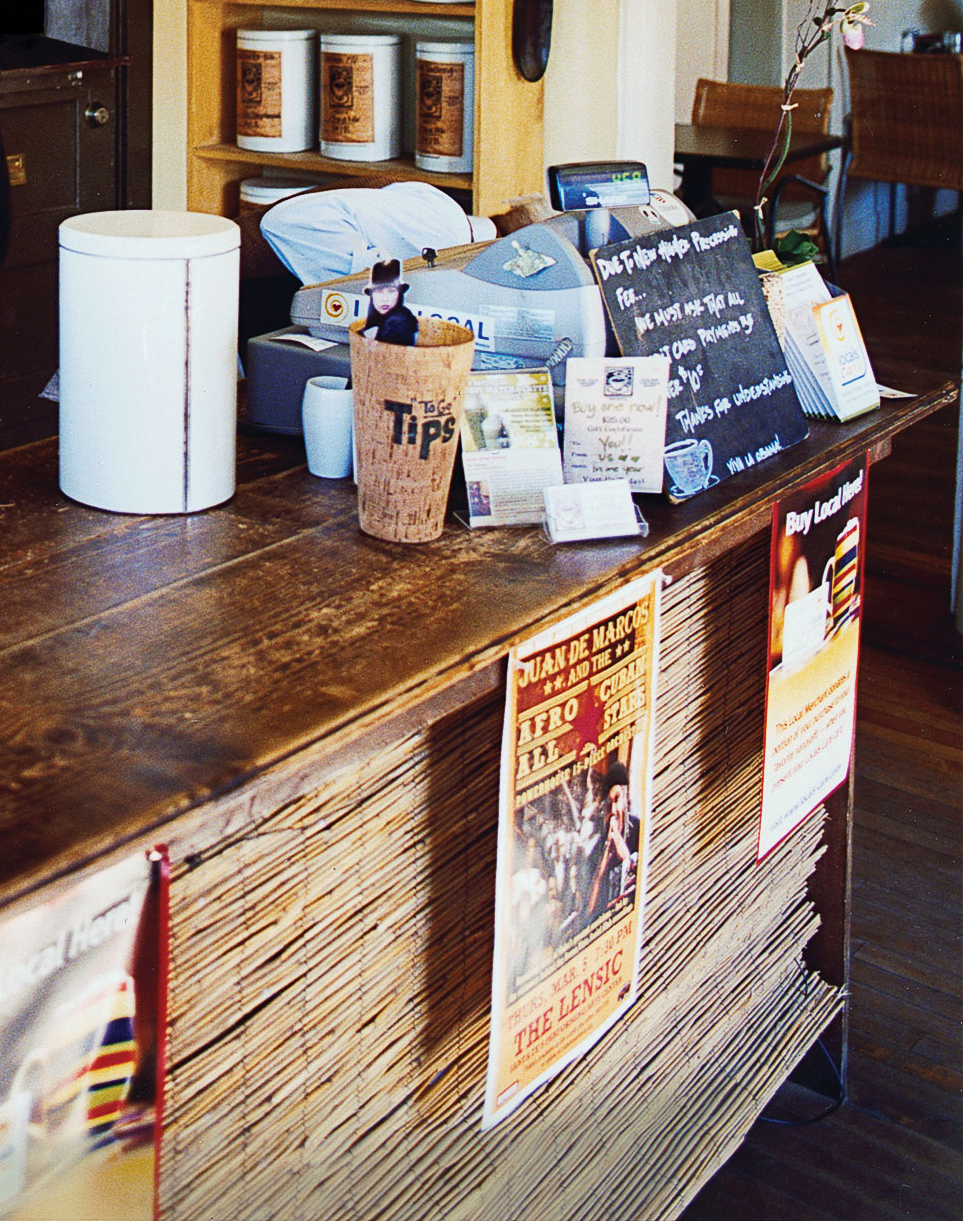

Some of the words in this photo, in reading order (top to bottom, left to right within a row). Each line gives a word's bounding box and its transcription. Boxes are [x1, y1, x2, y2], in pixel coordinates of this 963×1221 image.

[595, 254, 625, 281] DUE
[653, 302, 683, 327] MUST
[727, 291, 745, 307] ALL
[571, 401, 597, 419] Buy
[629, 395, 663, 419] now!
[674, 404, 714, 434] THANKS
[784, 507, 814, 538] Buy
[813, 487, 842, 523] Local
[838, 469, 865, 509] Here!
[518, 646, 567, 688] JUAN
[568, 633, 590, 664] DE
[592, 601, 650, 650] MARCOS
[591, 648, 612, 673] THE
[518, 698, 579, 748] AFRO
[598, 655, 648, 702] CUBAN
[516, 739, 560, 781] ALL
[603, 685, 647, 731] STARS
[513, 1006, 555, 1059] THE
[557, 948, 625, 1024] LENSIC
